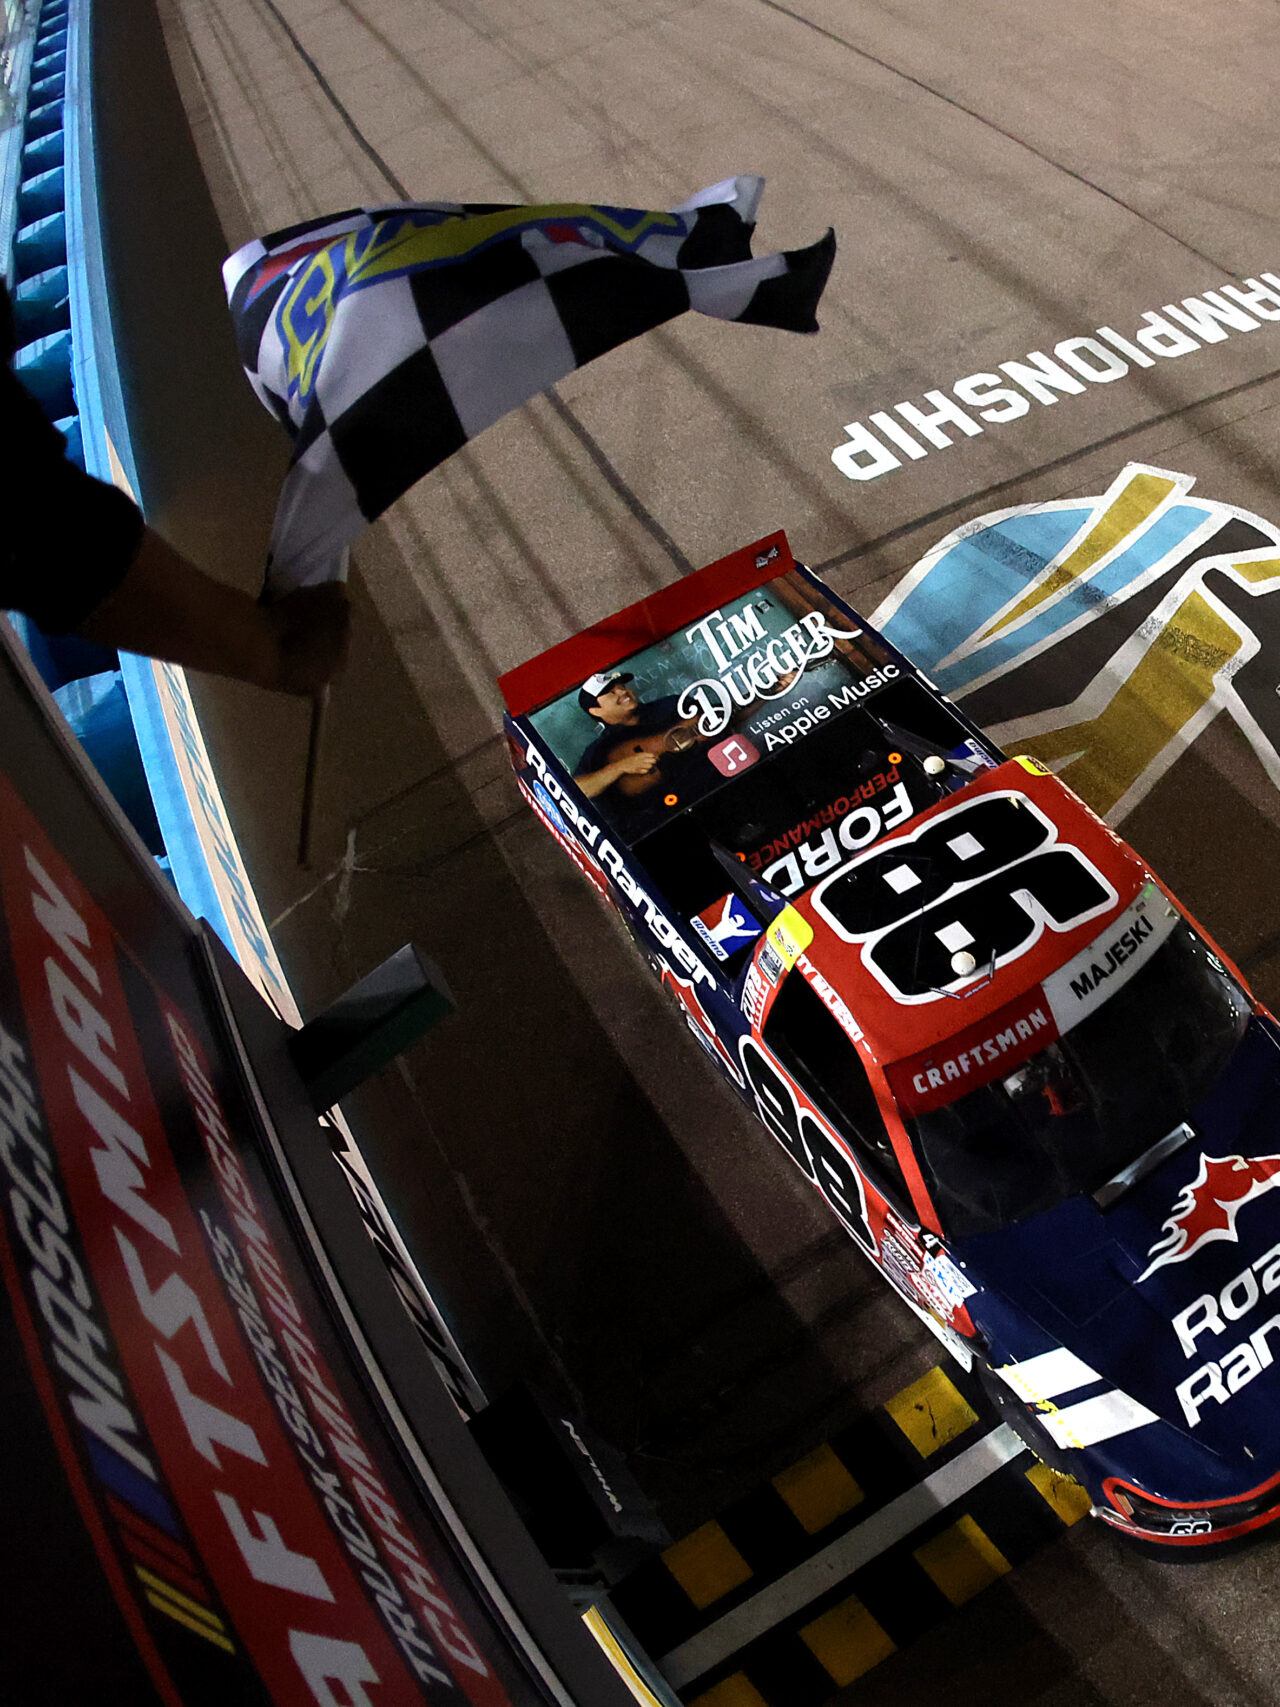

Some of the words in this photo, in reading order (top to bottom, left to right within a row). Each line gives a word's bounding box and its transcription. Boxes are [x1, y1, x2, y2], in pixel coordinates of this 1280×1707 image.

[677, 611, 863, 737] DUGGER
[686, 603, 768, 674] TIM
[750, 706, 791, 735] Listen
[791, 696, 810, 710] on
[763, 703, 831, 752] Apple
[828, 664, 900, 710] Music
[525, 742, 601, 847] Road
[598, 838, 717, 991] Ranger
[750, 765, 901, 871] PERFORMANCE
[762, 781, 914, 897] FORD
[811, 790, 1119, 1006] 98
[1069, 914, 1155, 1000] MAJESKI
[913, 1008, 1049, 1094] CRAFTSMAN
[166, 1012, 489, 1678] CHAMPIONSHIP
[199, 1207, 324, 1461] SERIES
[309, 1466, 454, 1688] TRUCK
